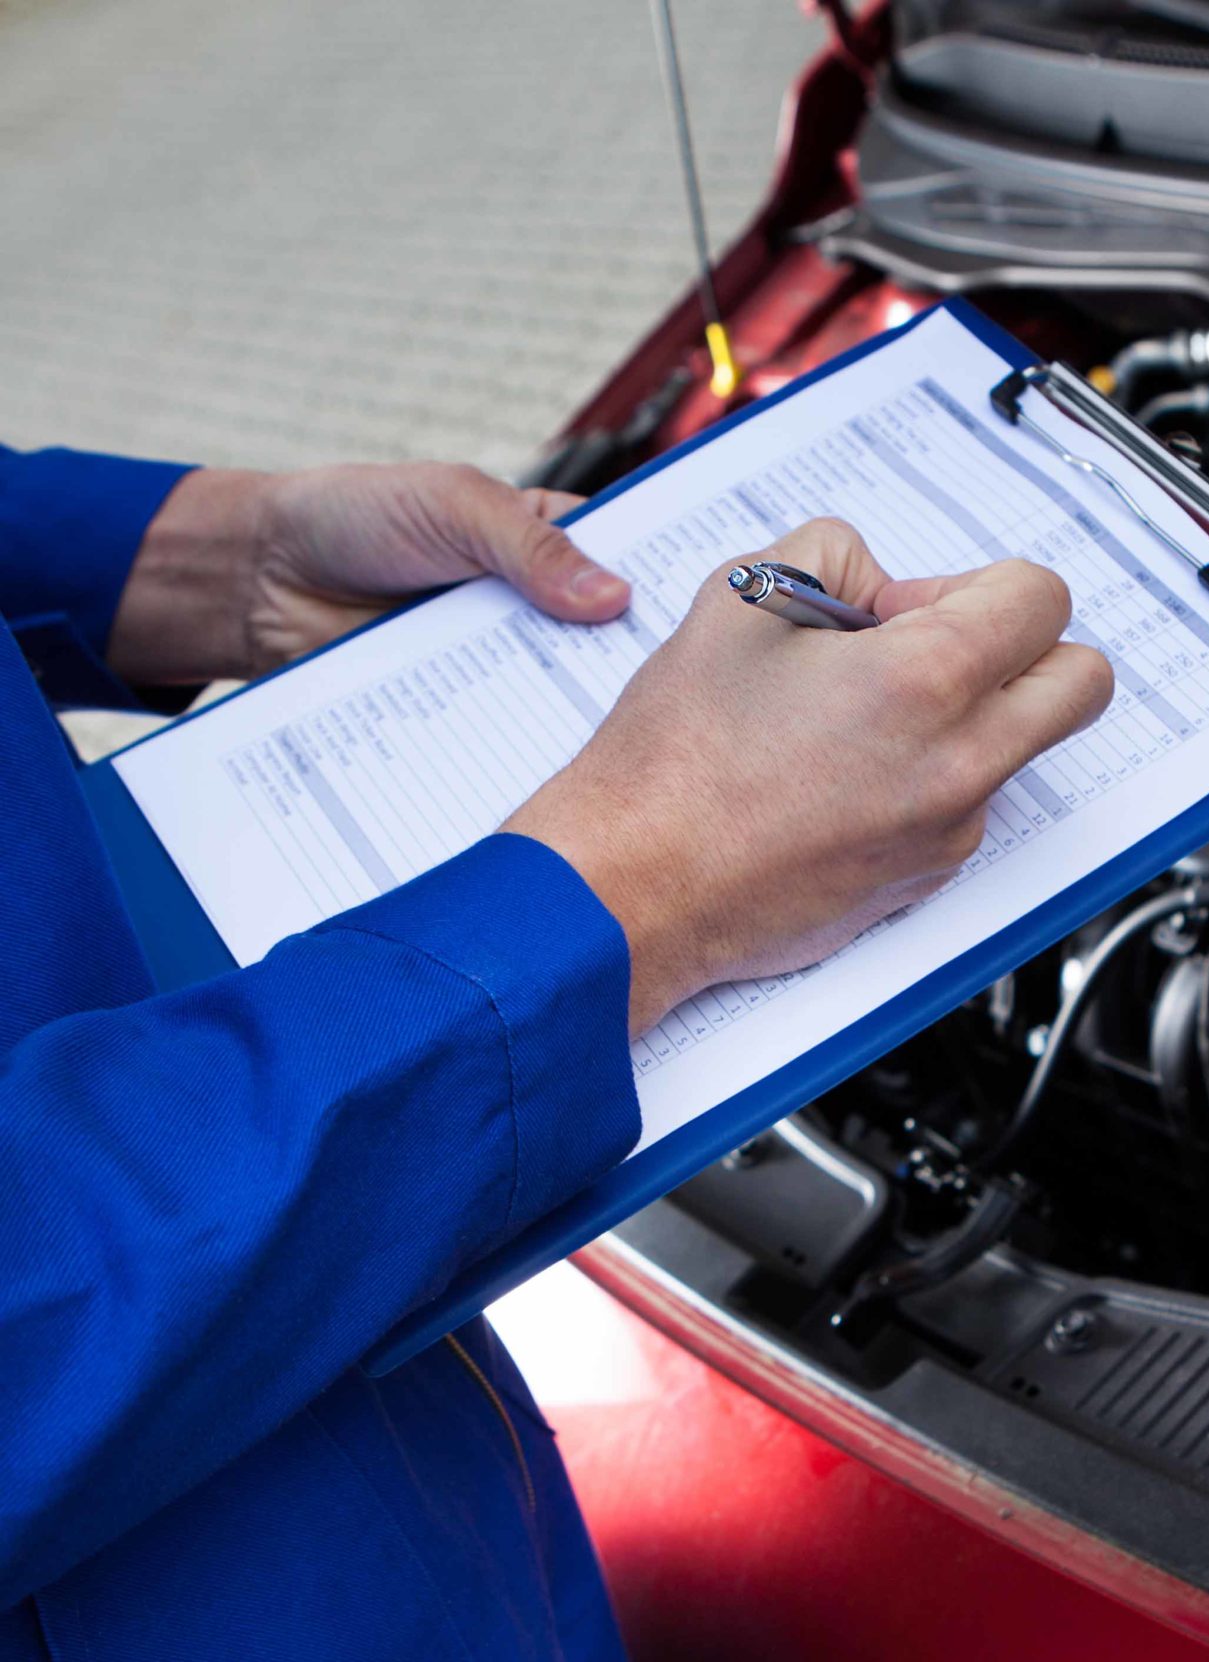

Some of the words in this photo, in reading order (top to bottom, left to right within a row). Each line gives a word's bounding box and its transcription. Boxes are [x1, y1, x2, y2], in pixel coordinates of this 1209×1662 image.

[1173, 651, 1195, 668] 250
[1158, 661, 1179, 678] 250
[1117, 693, 1132, 705] 15
[1159, 733, 1173, 744] 14
[1127, 753, 1143, 765] 19
[1095, 772, 1111, 784] 23
[1063, 792, 1078, 805] 21
[1031, 812, 1047, 825] 12
